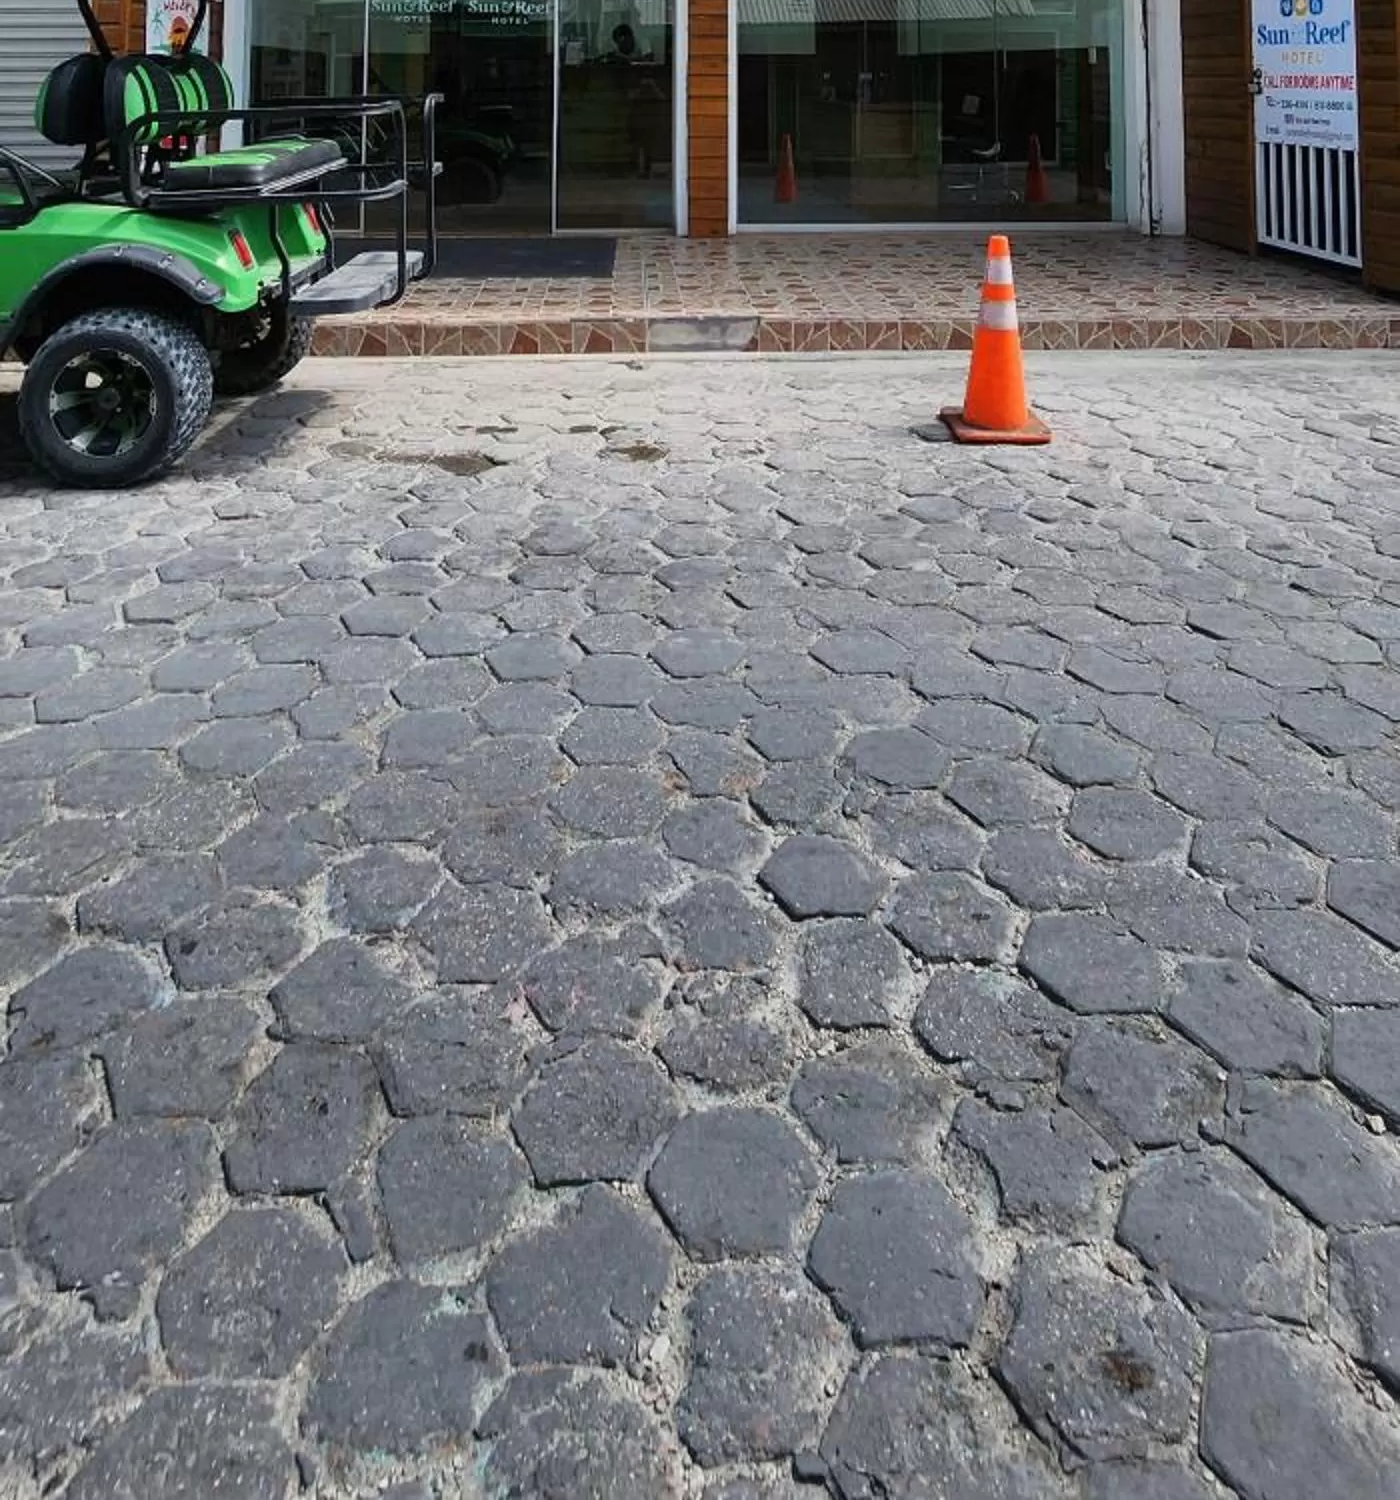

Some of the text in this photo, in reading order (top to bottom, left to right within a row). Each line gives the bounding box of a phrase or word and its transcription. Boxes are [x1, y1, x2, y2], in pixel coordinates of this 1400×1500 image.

[491, 16, 529, 25] HOTEL
[1281, 51, 1324, 66] HOTEL
[1320, 75, 1355, 90] ANYTIME
